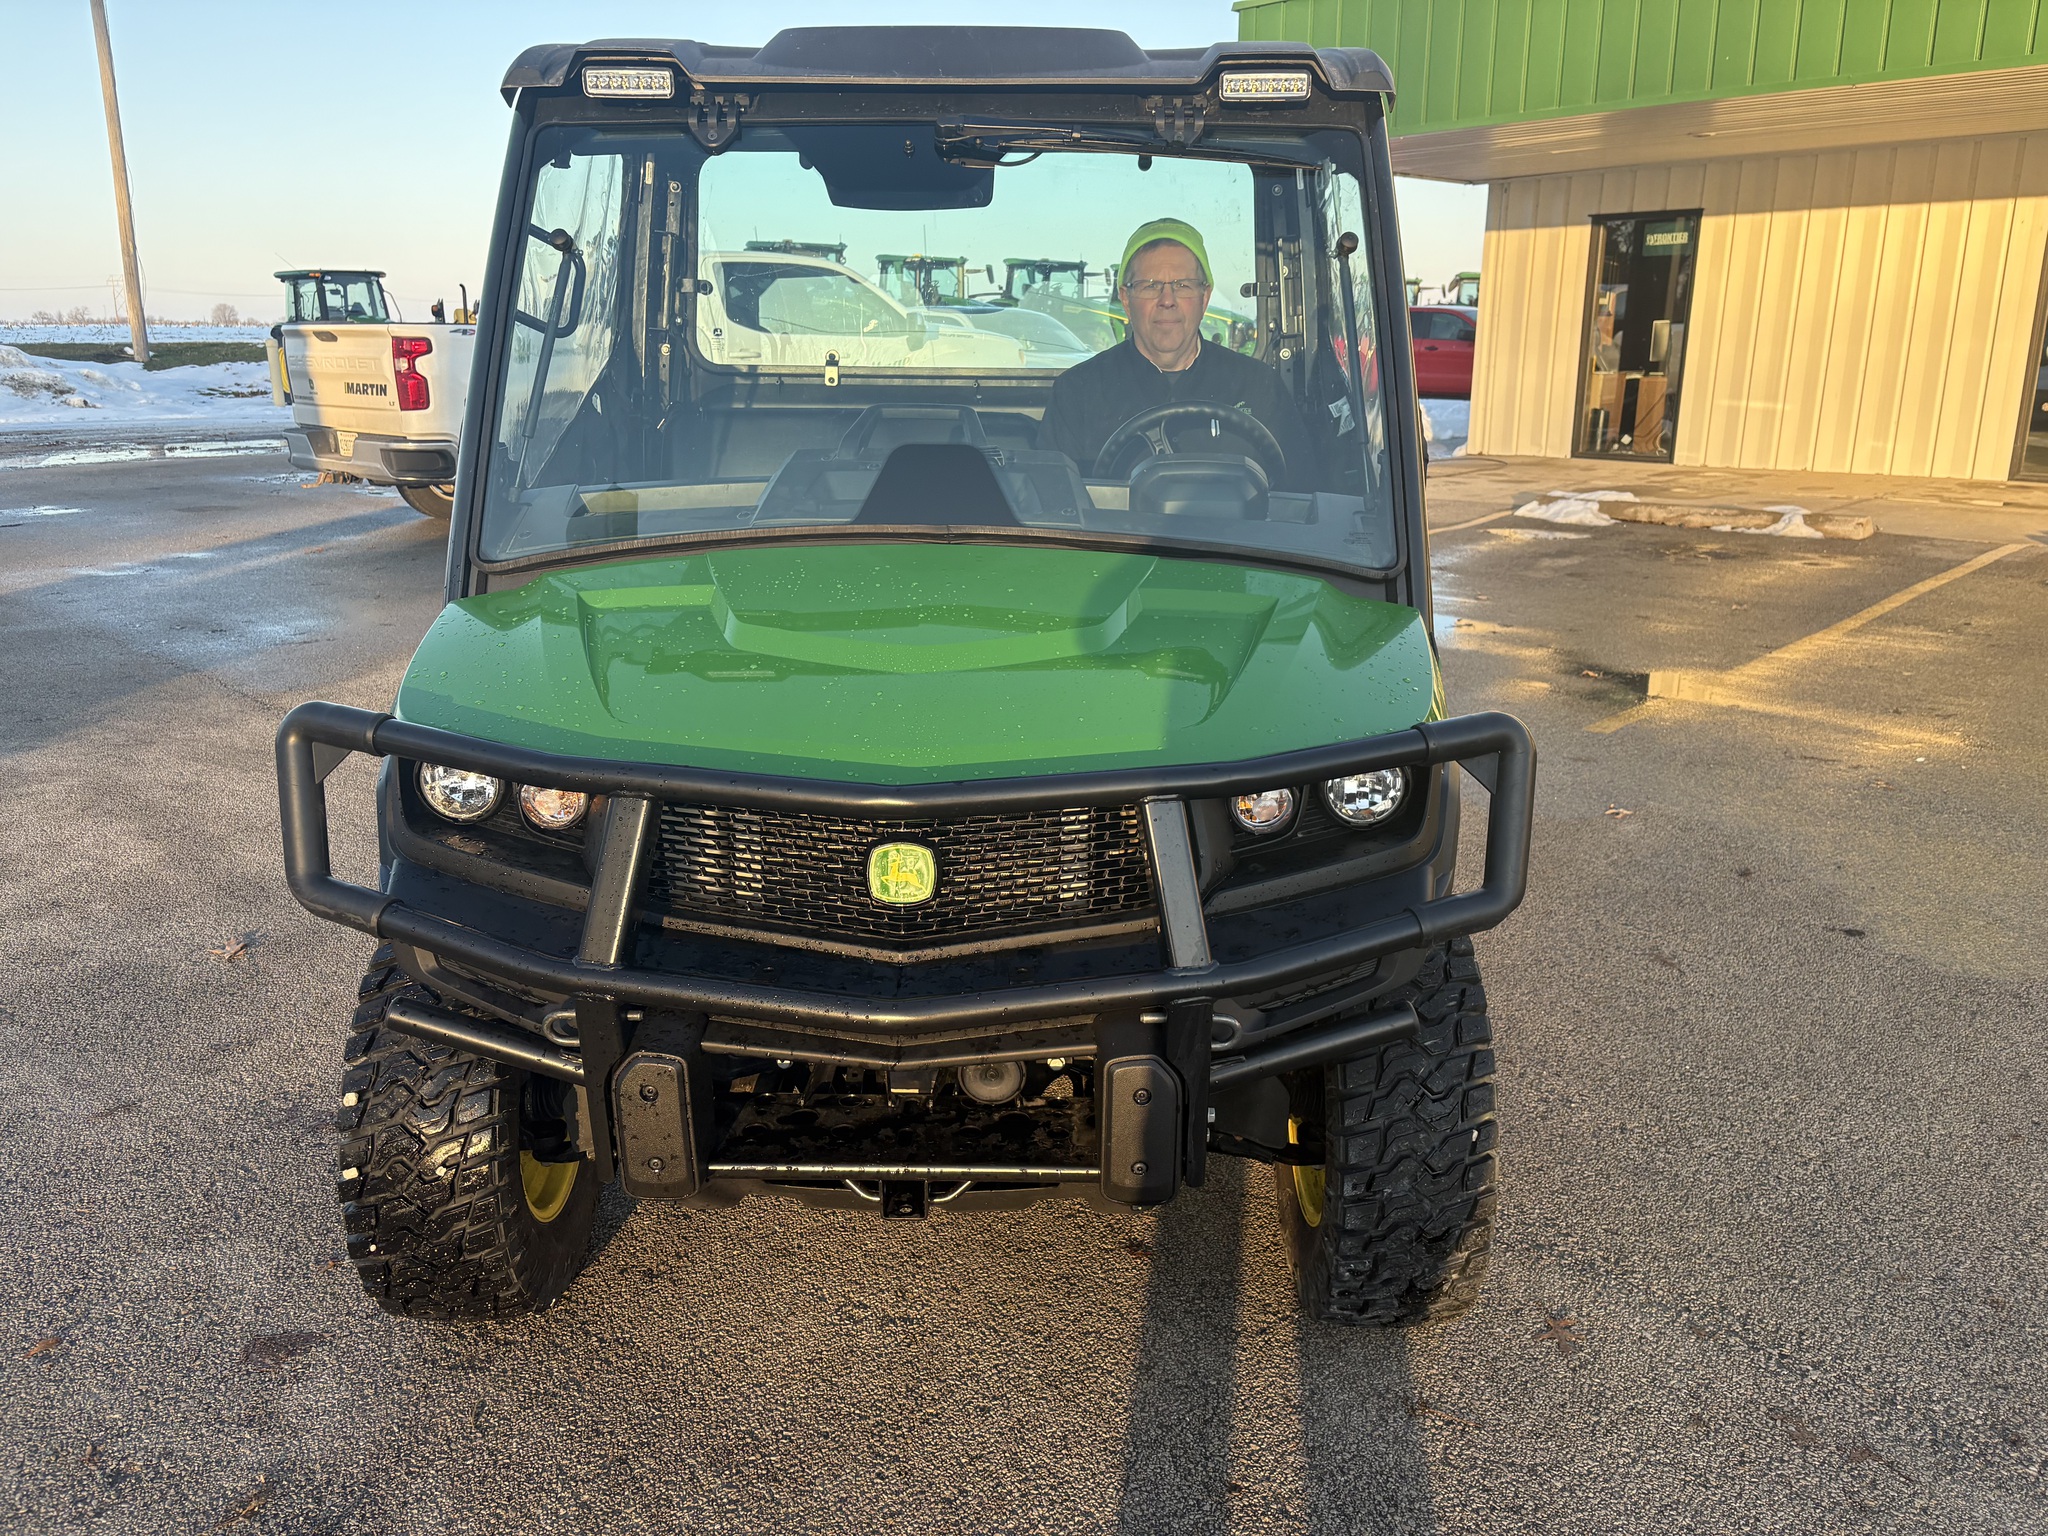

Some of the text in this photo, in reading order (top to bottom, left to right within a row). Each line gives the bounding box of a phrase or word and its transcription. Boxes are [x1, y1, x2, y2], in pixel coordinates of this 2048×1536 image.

[1653, 232, 1688, 246] FRONTIER
[288, 356, 380, 371] CHEVROLET
[346, 382, 387, 396] MARTIN
